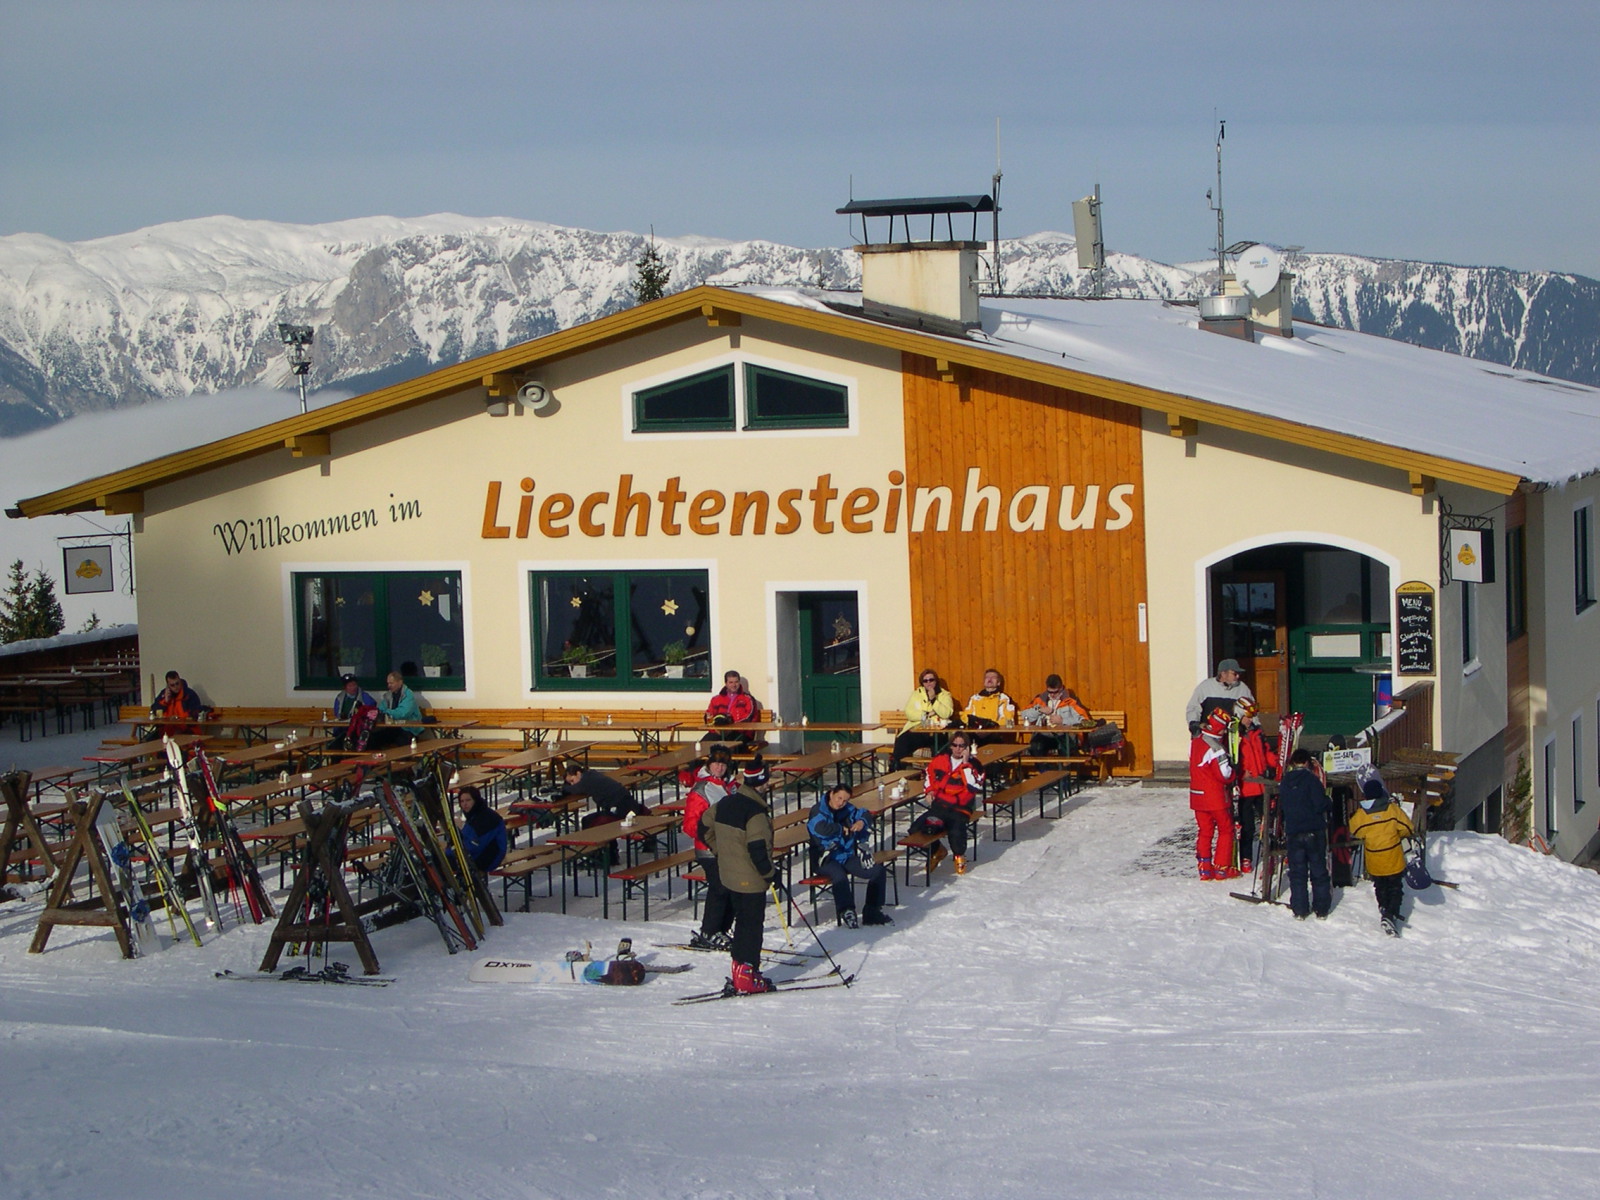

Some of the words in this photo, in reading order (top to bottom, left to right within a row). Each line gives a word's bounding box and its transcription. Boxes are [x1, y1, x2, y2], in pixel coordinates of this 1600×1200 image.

[212, 515, 379, 556] Willkommen
[389, 493, 423, 523] im
[481, 467, 1135, 540] Liechtensteinhaus
